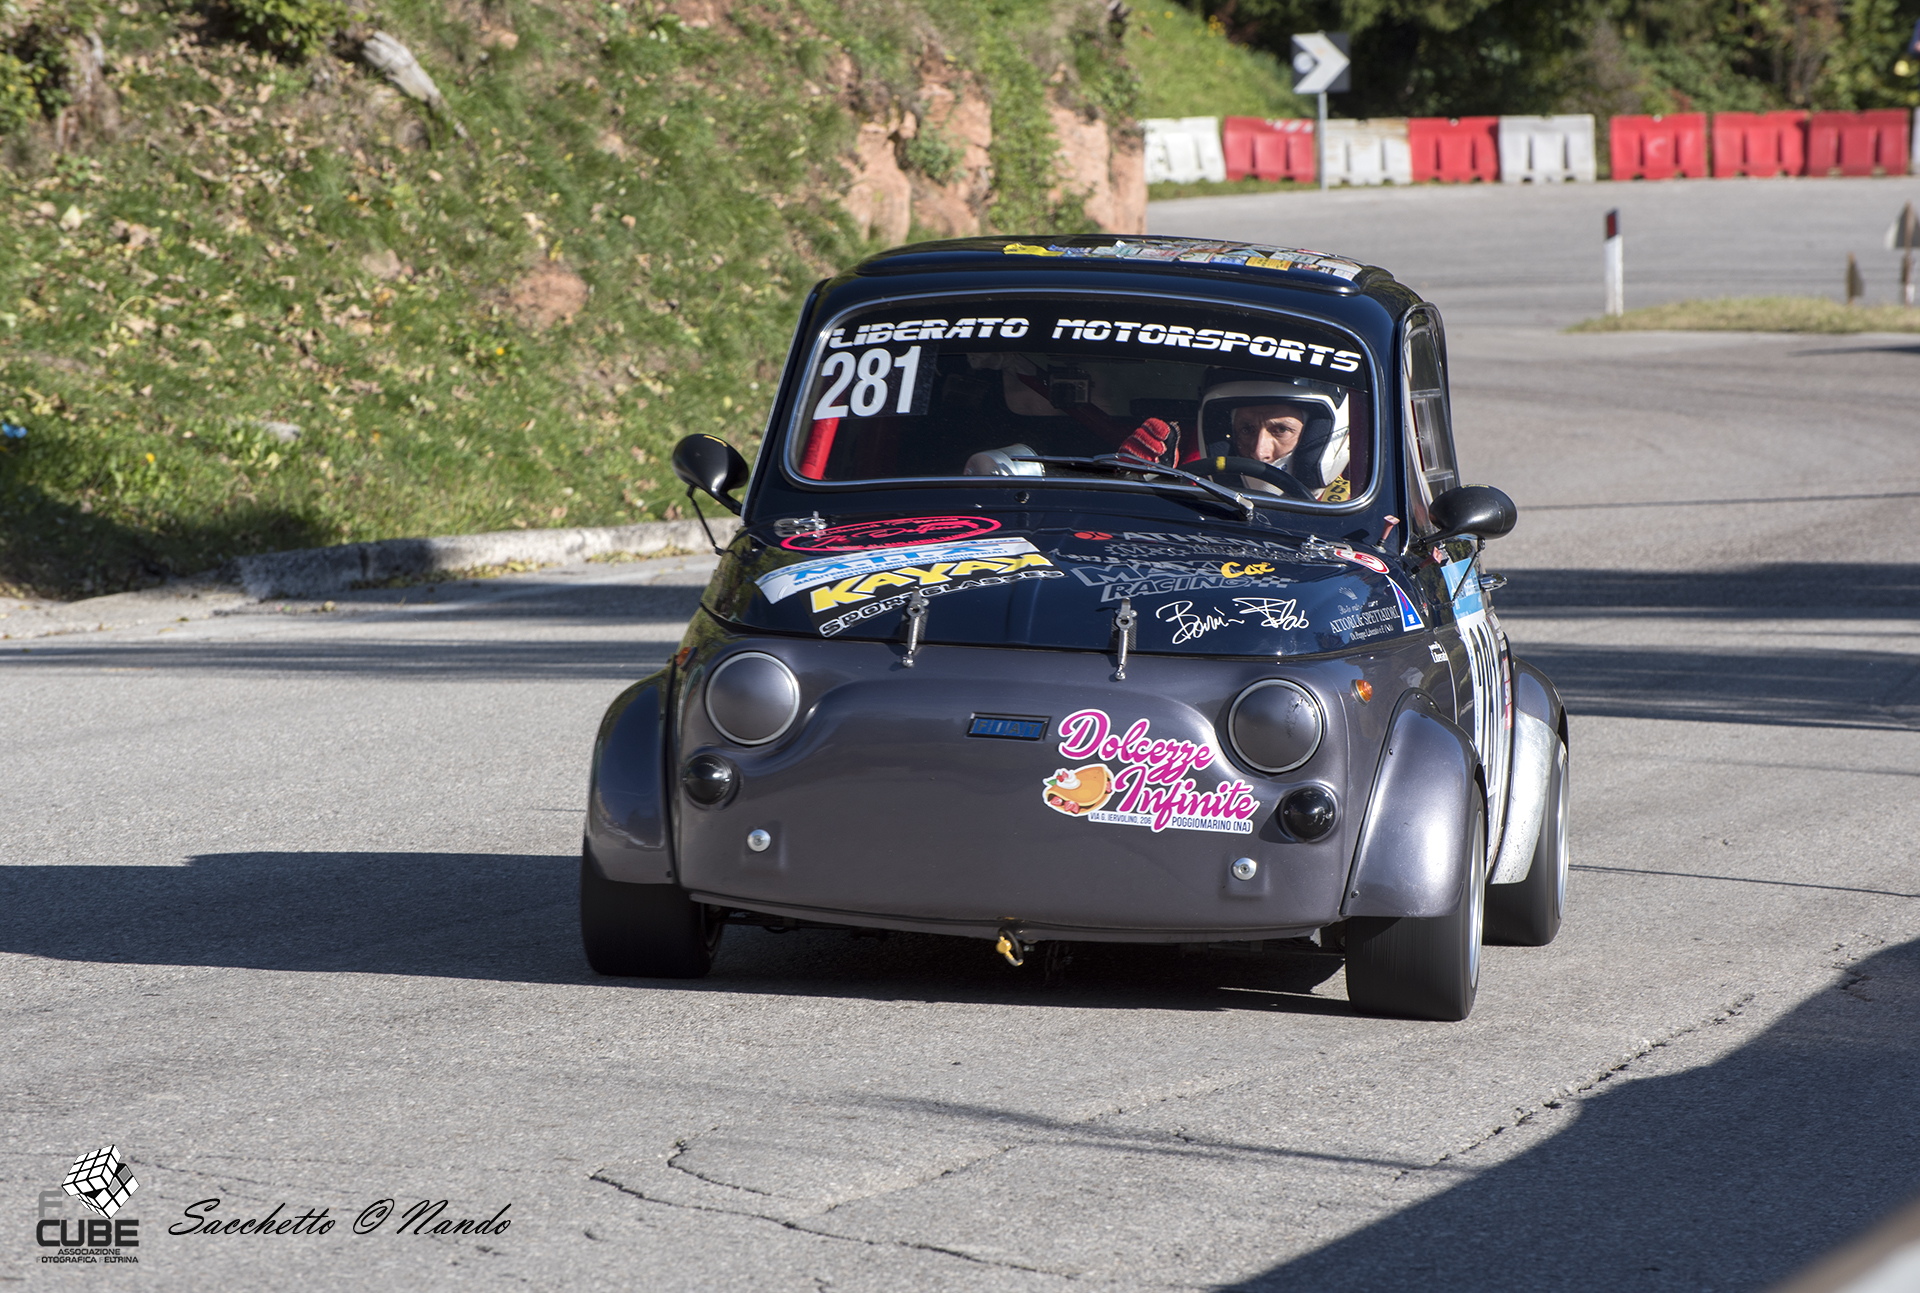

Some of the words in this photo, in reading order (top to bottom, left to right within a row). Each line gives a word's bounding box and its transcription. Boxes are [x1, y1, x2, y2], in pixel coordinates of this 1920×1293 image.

[829, 317, 1030, 349] LIBERATO
[1051, 317, 1362, 374] MOTORSPORTS
[812, 345, 922, 420] 281
[1123, 532, 1288, 551] ATHENA
[810, 553, 1054, 613] KAYAK
[1220, 561, 1276, 579] Car
[1100, 576, 1251, 603] RACING
[976, 720, 1039, 736] FIAT
[1059, 711, 1214, 782] Dolcezze
[1114, 765, 1259, 830] Infinite
[1140, 816, 1152, 824] 206
[1171, 816, 1232, 831] POGGIOMARINO
[1233, 820, 1252, 832] (NA)
